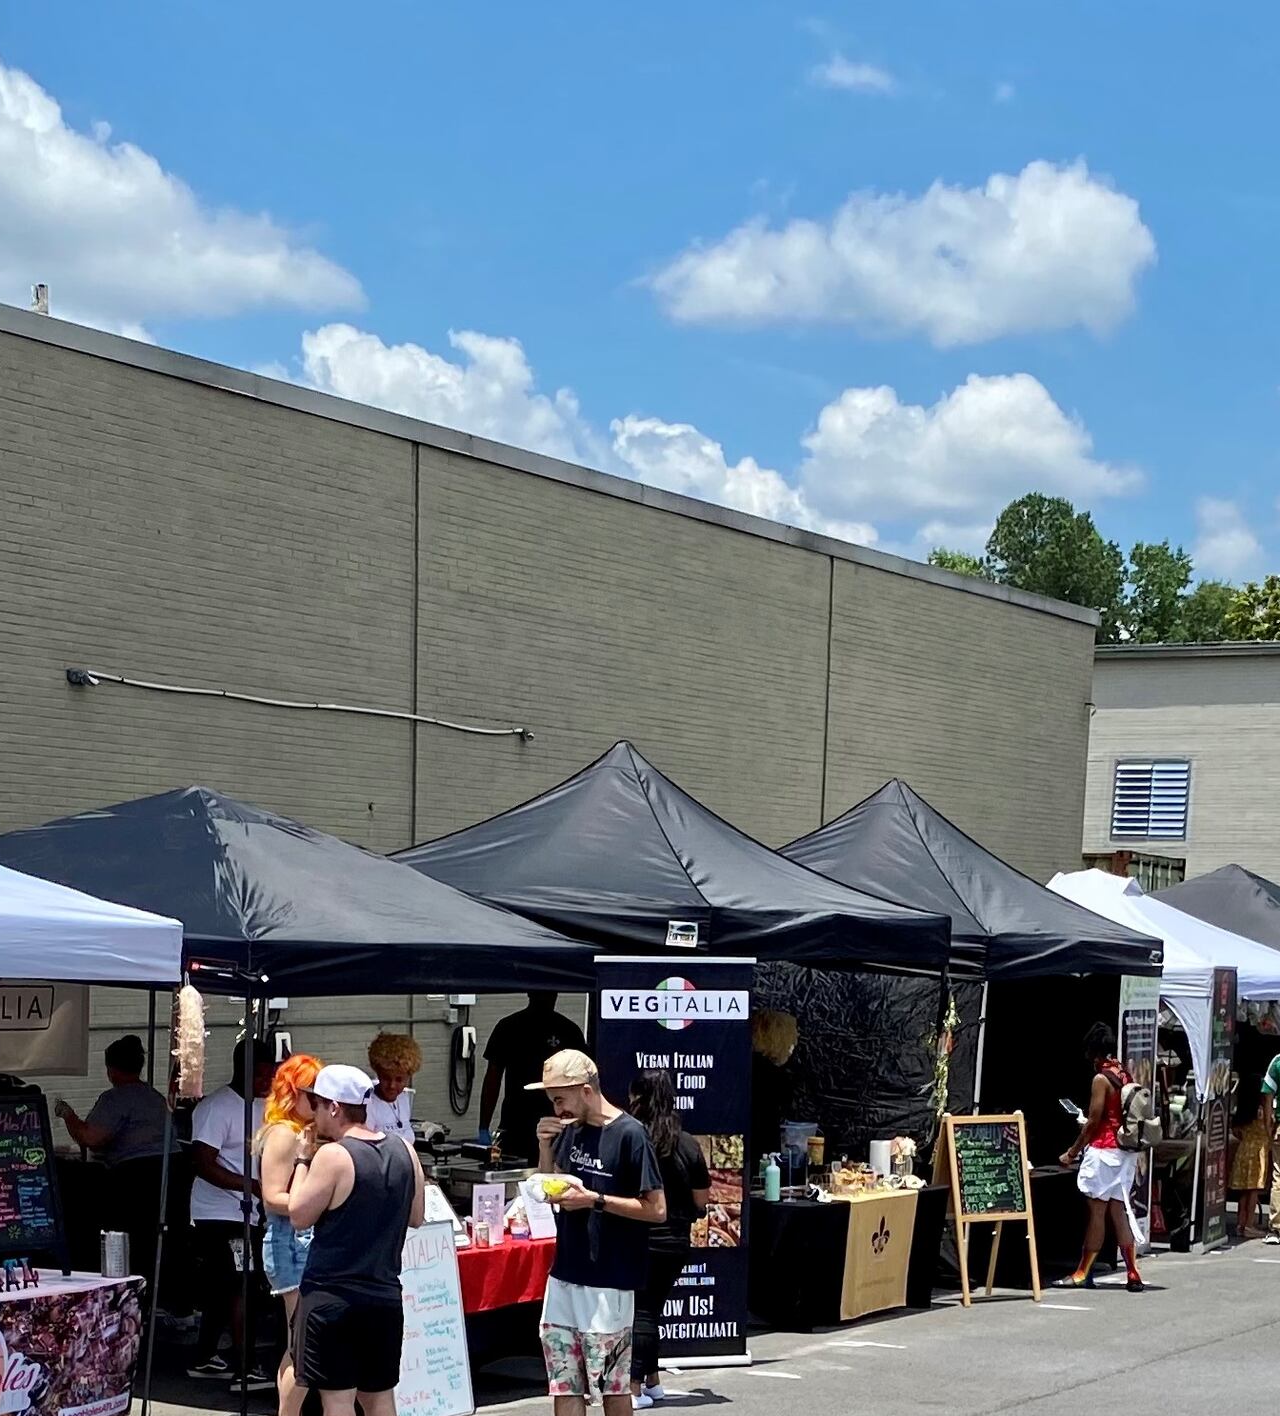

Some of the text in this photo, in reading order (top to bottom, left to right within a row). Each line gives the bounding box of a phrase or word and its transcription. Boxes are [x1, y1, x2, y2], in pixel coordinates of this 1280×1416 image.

[636, 1051, 714, 1069] VEGAN ITALIAN
[676, 1072, 706, 1089] FOOD
[673, 1096, 695, 1110] ION
[404, 1234, 453, 1268] ITALIA
[661, 1299, 685, 1317] OW
